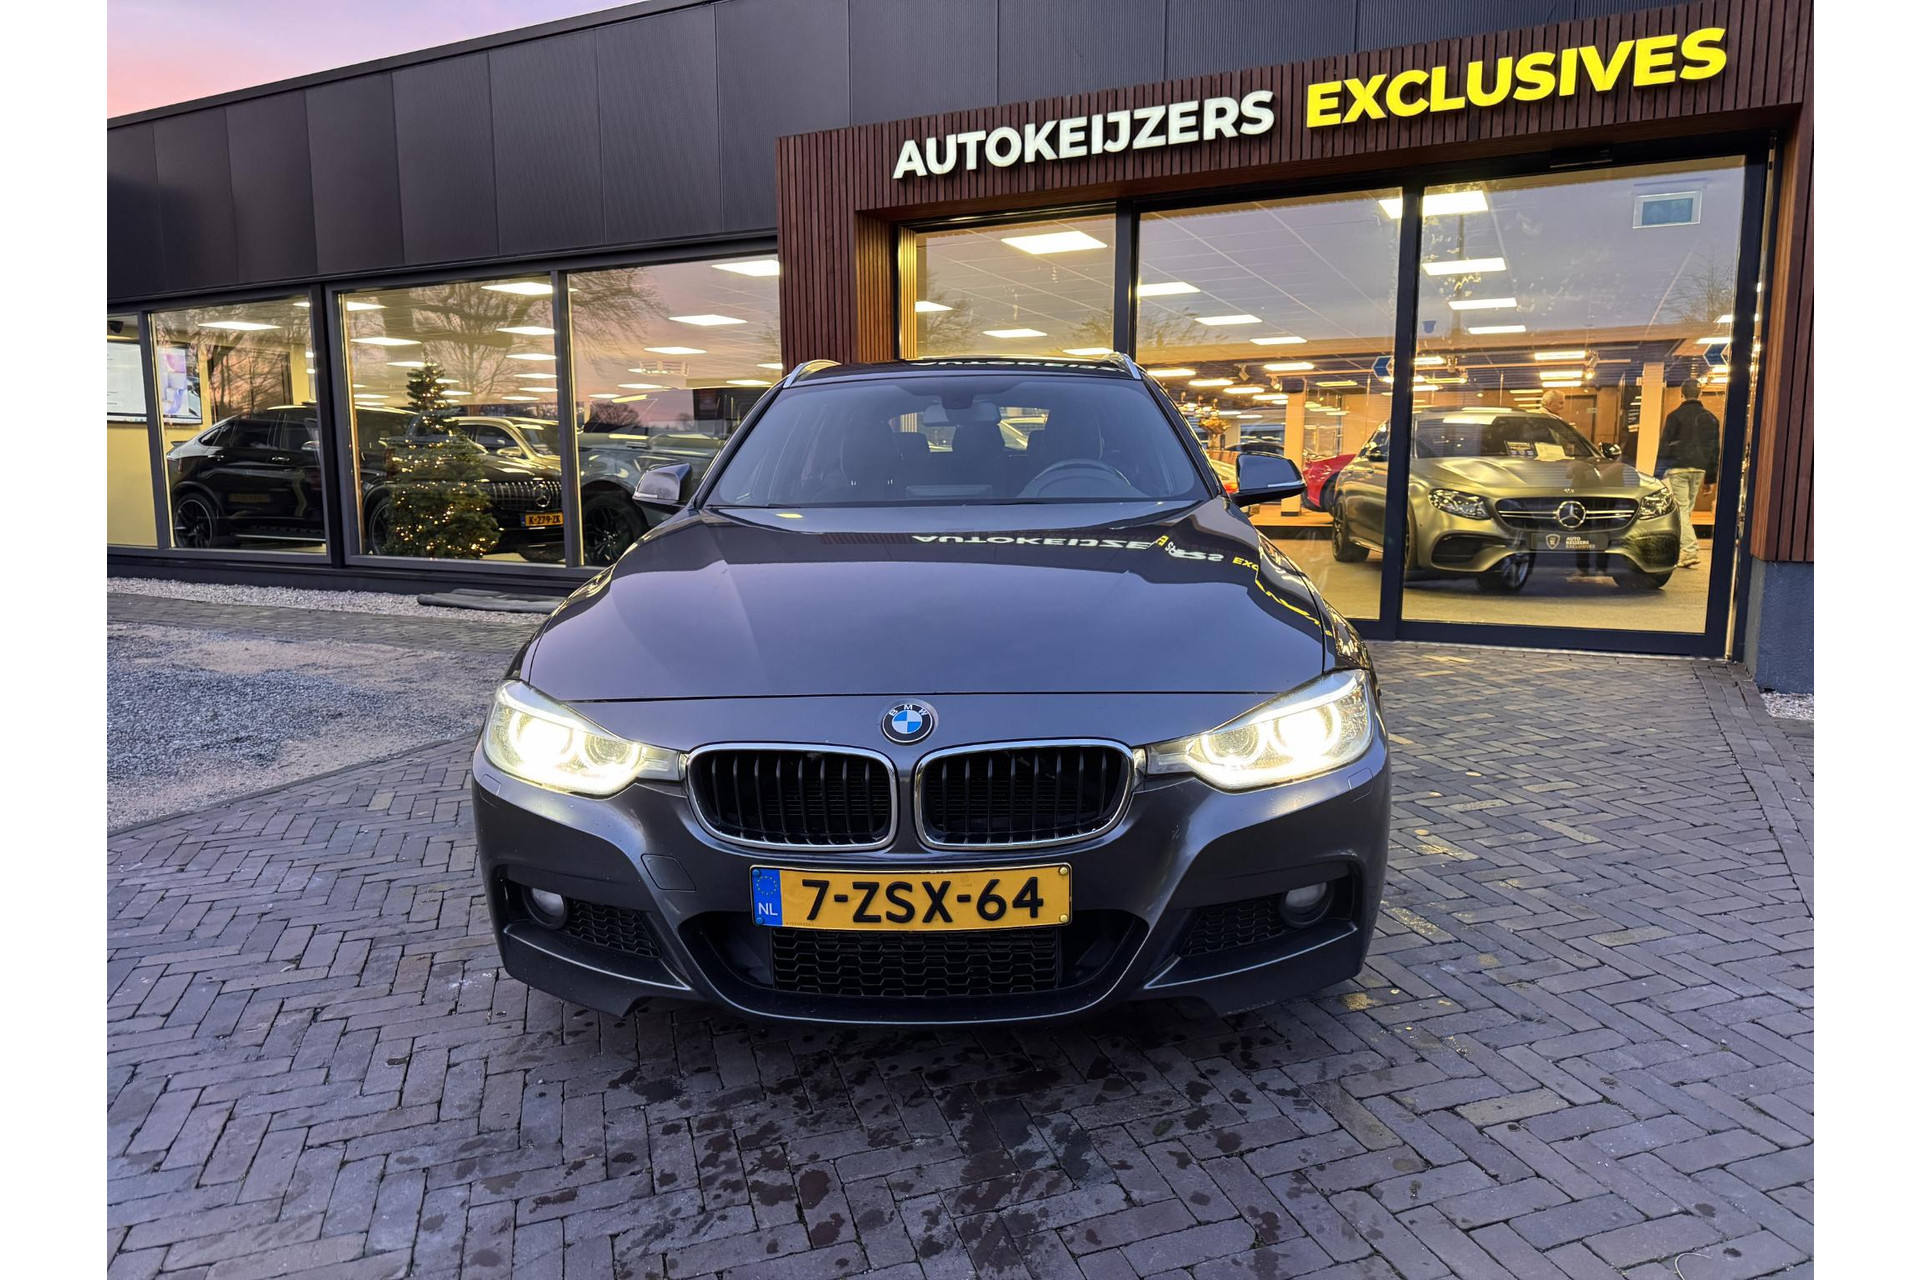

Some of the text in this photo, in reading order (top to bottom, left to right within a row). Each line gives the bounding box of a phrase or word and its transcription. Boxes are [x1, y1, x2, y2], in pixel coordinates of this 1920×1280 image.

[893, 27, 1727, 180] AUTOKEIJZERS EXCLUSIVES
[888, 704, 928, 716] BMW
[758, 902, 779, 916] NL
[802, 877, 1044, 924] 7-ZSX-64
